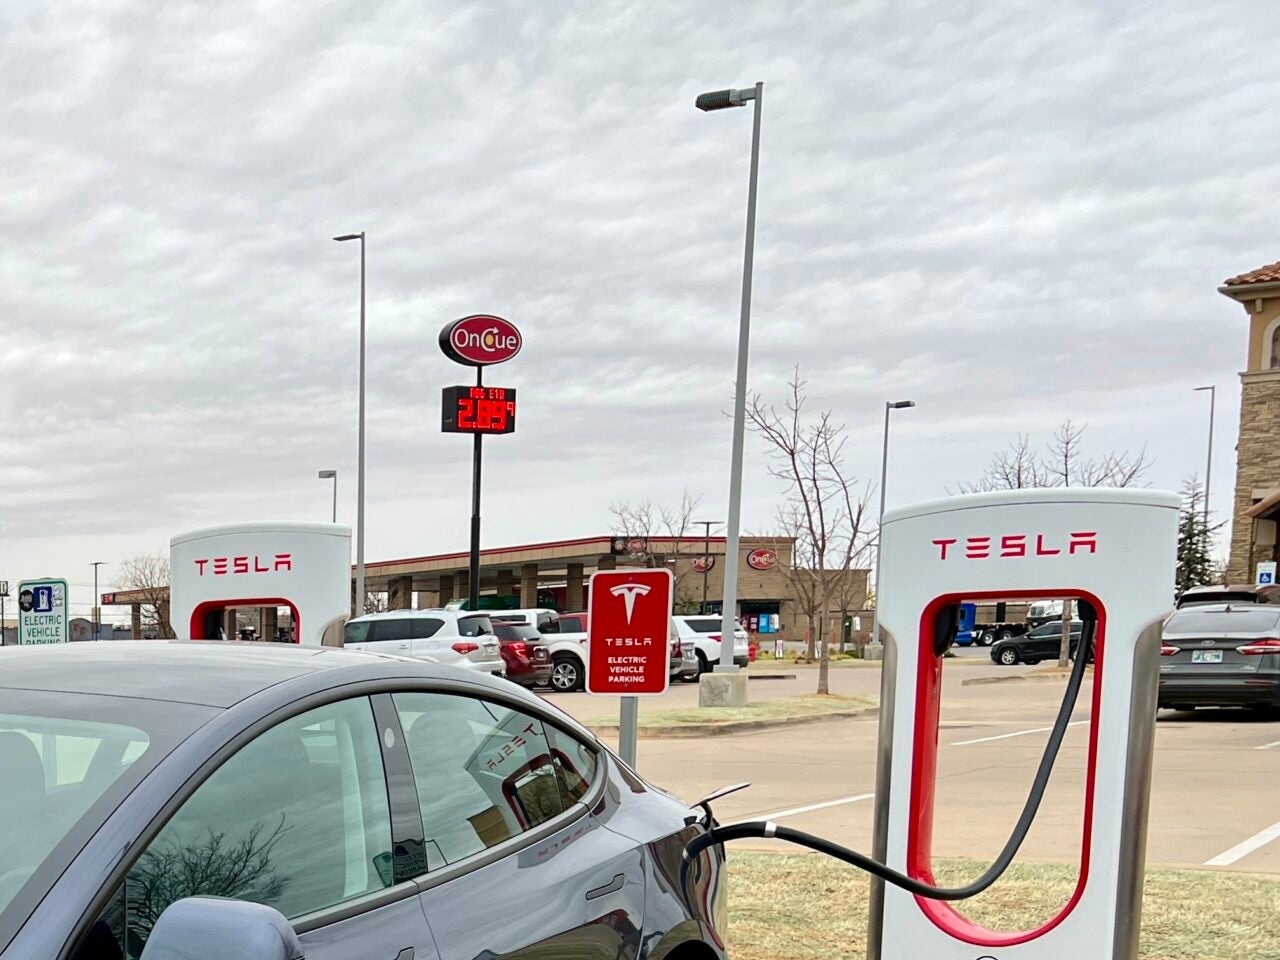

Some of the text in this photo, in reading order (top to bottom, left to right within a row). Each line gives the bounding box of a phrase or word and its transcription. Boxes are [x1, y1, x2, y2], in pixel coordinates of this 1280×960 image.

[454, 327, 517, 352] OnCue
[489, 388, 504, 399] E10
[931, 532, 1098, 560] TESLA
[194, 554, 291, 576] TESLA
[24, 615, 61, 626] ELECTRIC
[27, 627, 60, 638] VEHICLE
[605, 637, 652, 646] TESLA
[607, 656, 647, 664] ELECTRIC
